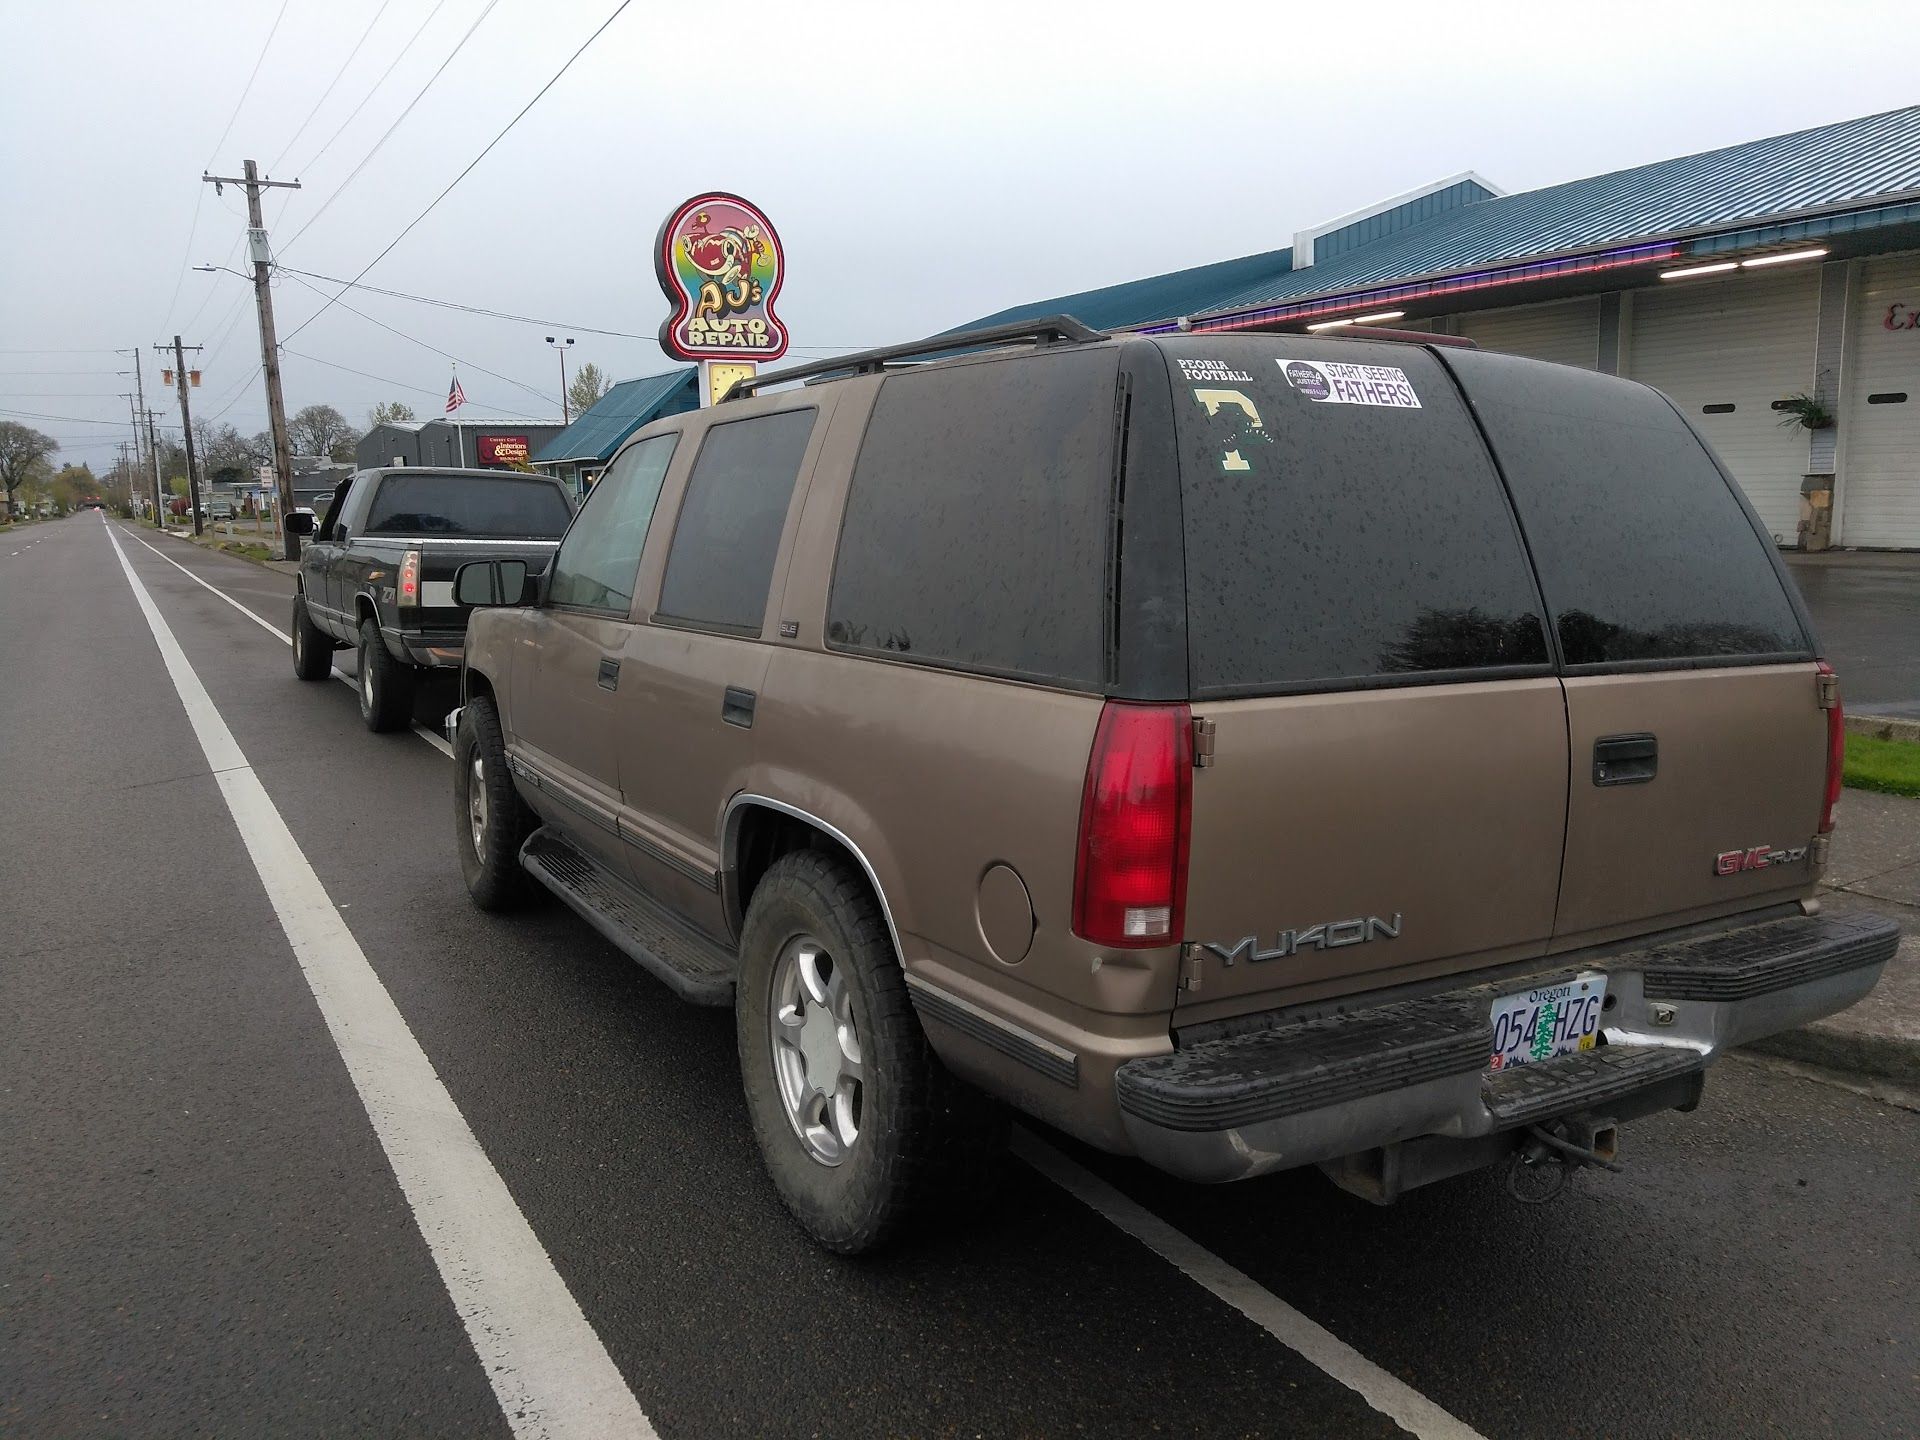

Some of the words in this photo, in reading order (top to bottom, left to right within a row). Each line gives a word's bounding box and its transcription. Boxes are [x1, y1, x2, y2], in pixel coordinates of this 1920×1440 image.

[688, 317, 766, 334] AUTO
[688, 332, 769, 346] REPAIR
[1177, 359, 1229, 370] PEORIA
[1182, 368, 1254, 382] FOOTBALL
[1287, 369, 1316, 379] FATHERS
[1325, 363, 1362, 380] START
[1362, 366, 1407, 383] SEEING
[1296, 378, 1321, 386] JUSTICE
[1333, 380, 1417, 406] FATHERS!
[495, 445, 505, 456] &
[500, 442, 527, 450] Interiors
[780, 623, 798, 634] SLE
[1716, 845, 1772, 875] GMC
[1202, 912, 1402, 966] YUKON
[1529, 986, 1571, 1004] Oregon
[1493, 1006, 1541, 1055] 054
[1551, 995, 1599, 1043] HZG
